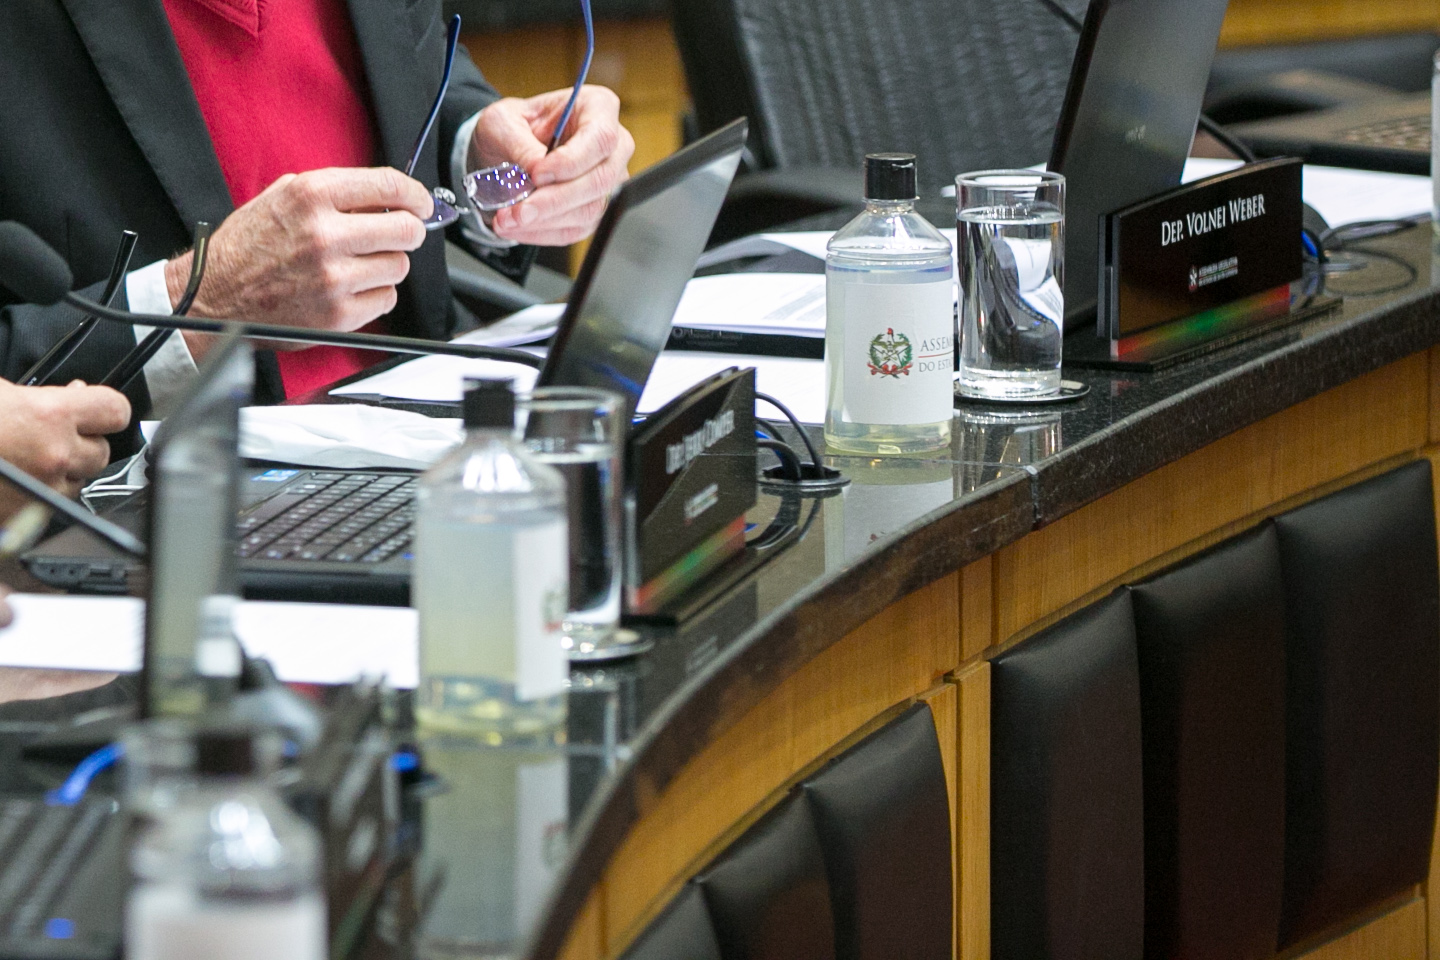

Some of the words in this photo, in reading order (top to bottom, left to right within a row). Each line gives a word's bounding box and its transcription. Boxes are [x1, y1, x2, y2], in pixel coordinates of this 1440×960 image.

[1161, 220, 1184, 247] DEP.
[1186, 206, 1226, 237] VOLNEI
[1229, 193, 1266, 224] WEBER
[919, 361, 935, 372] DO
